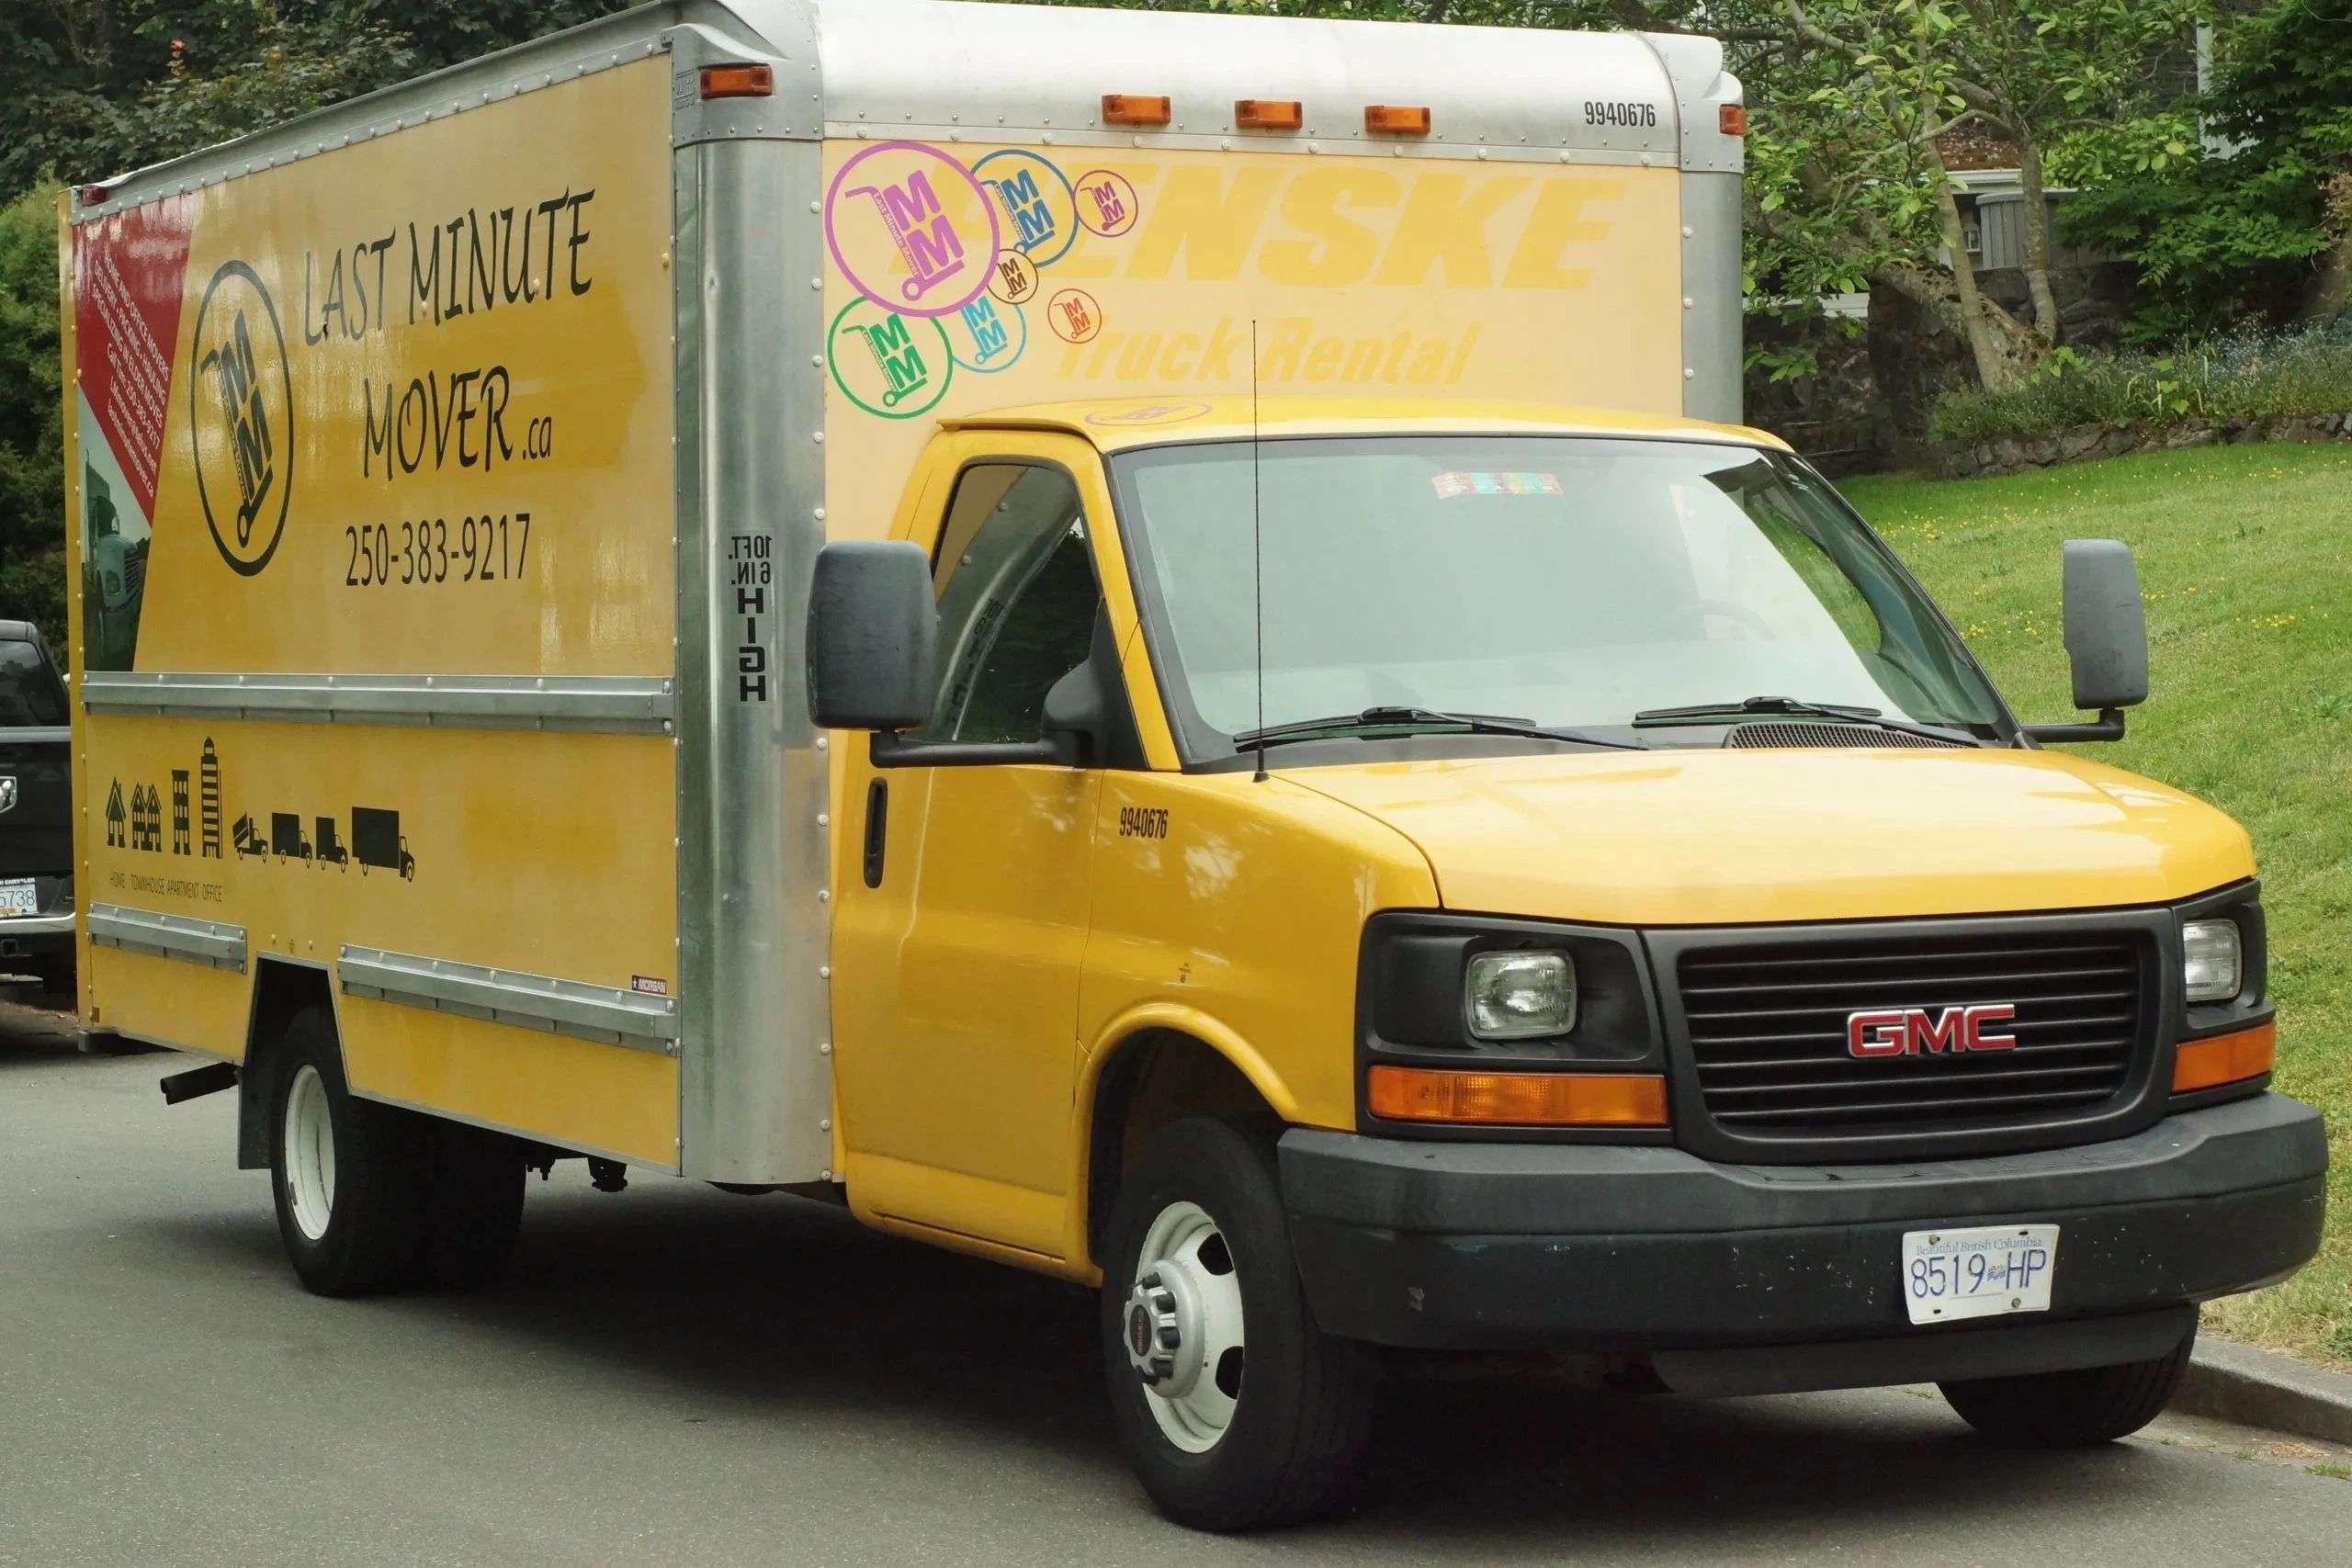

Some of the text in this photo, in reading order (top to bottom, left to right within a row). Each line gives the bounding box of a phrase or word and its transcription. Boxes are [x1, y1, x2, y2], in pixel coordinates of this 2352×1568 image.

[1583, 101, 1657, 127] 9940676
[304, 185, 596, 346] LAST MINUTE
[94, 259, 166, 405] DELIVERY PACKING HAULING
[119, 280, 130, 308] AND
[130, 301, 148, 343] OFFICE
[147, 333, 169, 382] MOVERS
[1259, 317, 1483, 384] Rental
[127, 379, 161, 450] 250-383-9217
[143, 386, 164, 429] MOVES
[345, 513, 530, 587] 250-383-9217
[1119, 807, 1169, 840] 9940676
[110, 872, 222, 903] HOME TOWNHOUSE APARTMENT OFFICE
[637, 978, 666, 994] MORGAN
[1847, 1003, 2016, 1058] GMC
[1916, 1236, 2042, 1256] Beautiful British Columbia
[1911, 1249, 2047, 1298] 8519 HP
